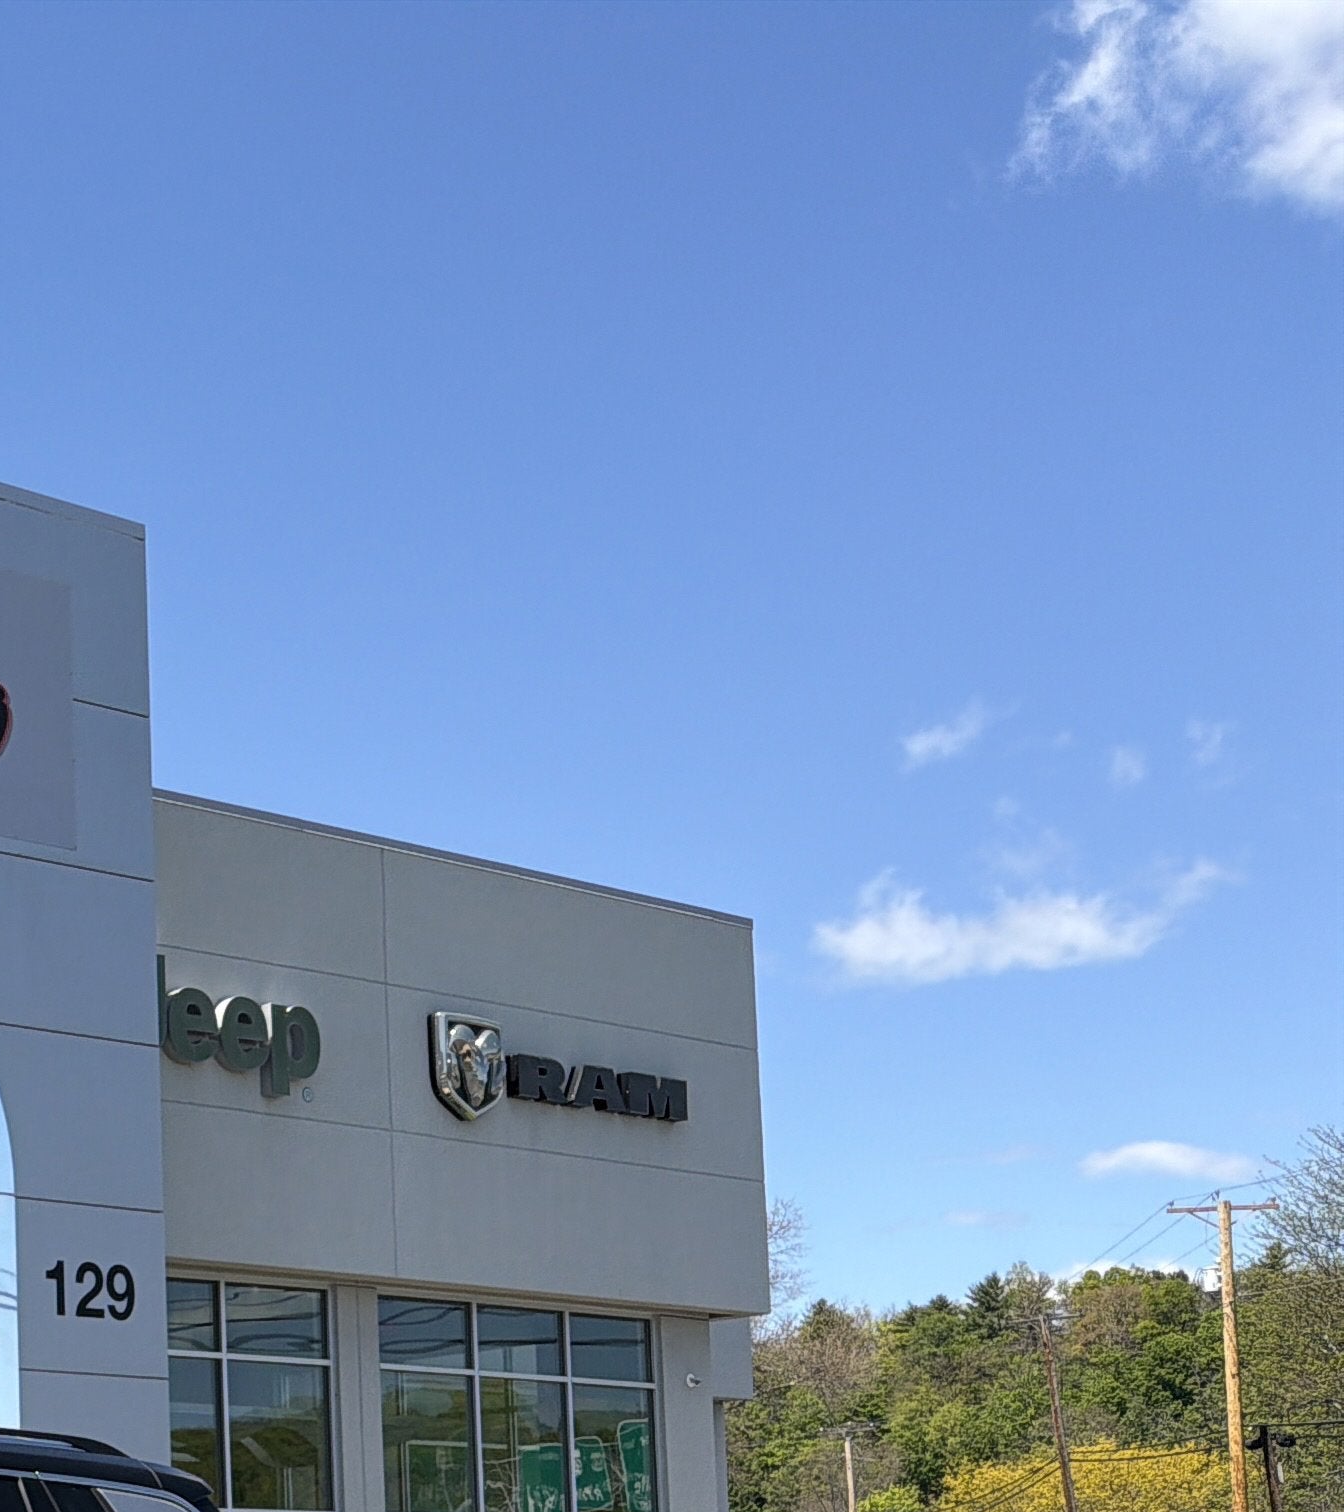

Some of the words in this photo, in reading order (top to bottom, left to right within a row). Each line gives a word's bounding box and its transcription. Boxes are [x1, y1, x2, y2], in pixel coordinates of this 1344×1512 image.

[157, 955, 321, 1098] eep
[505, 1053, 689, 1123] RAM
[44, 1259, 136, 1322] 129
